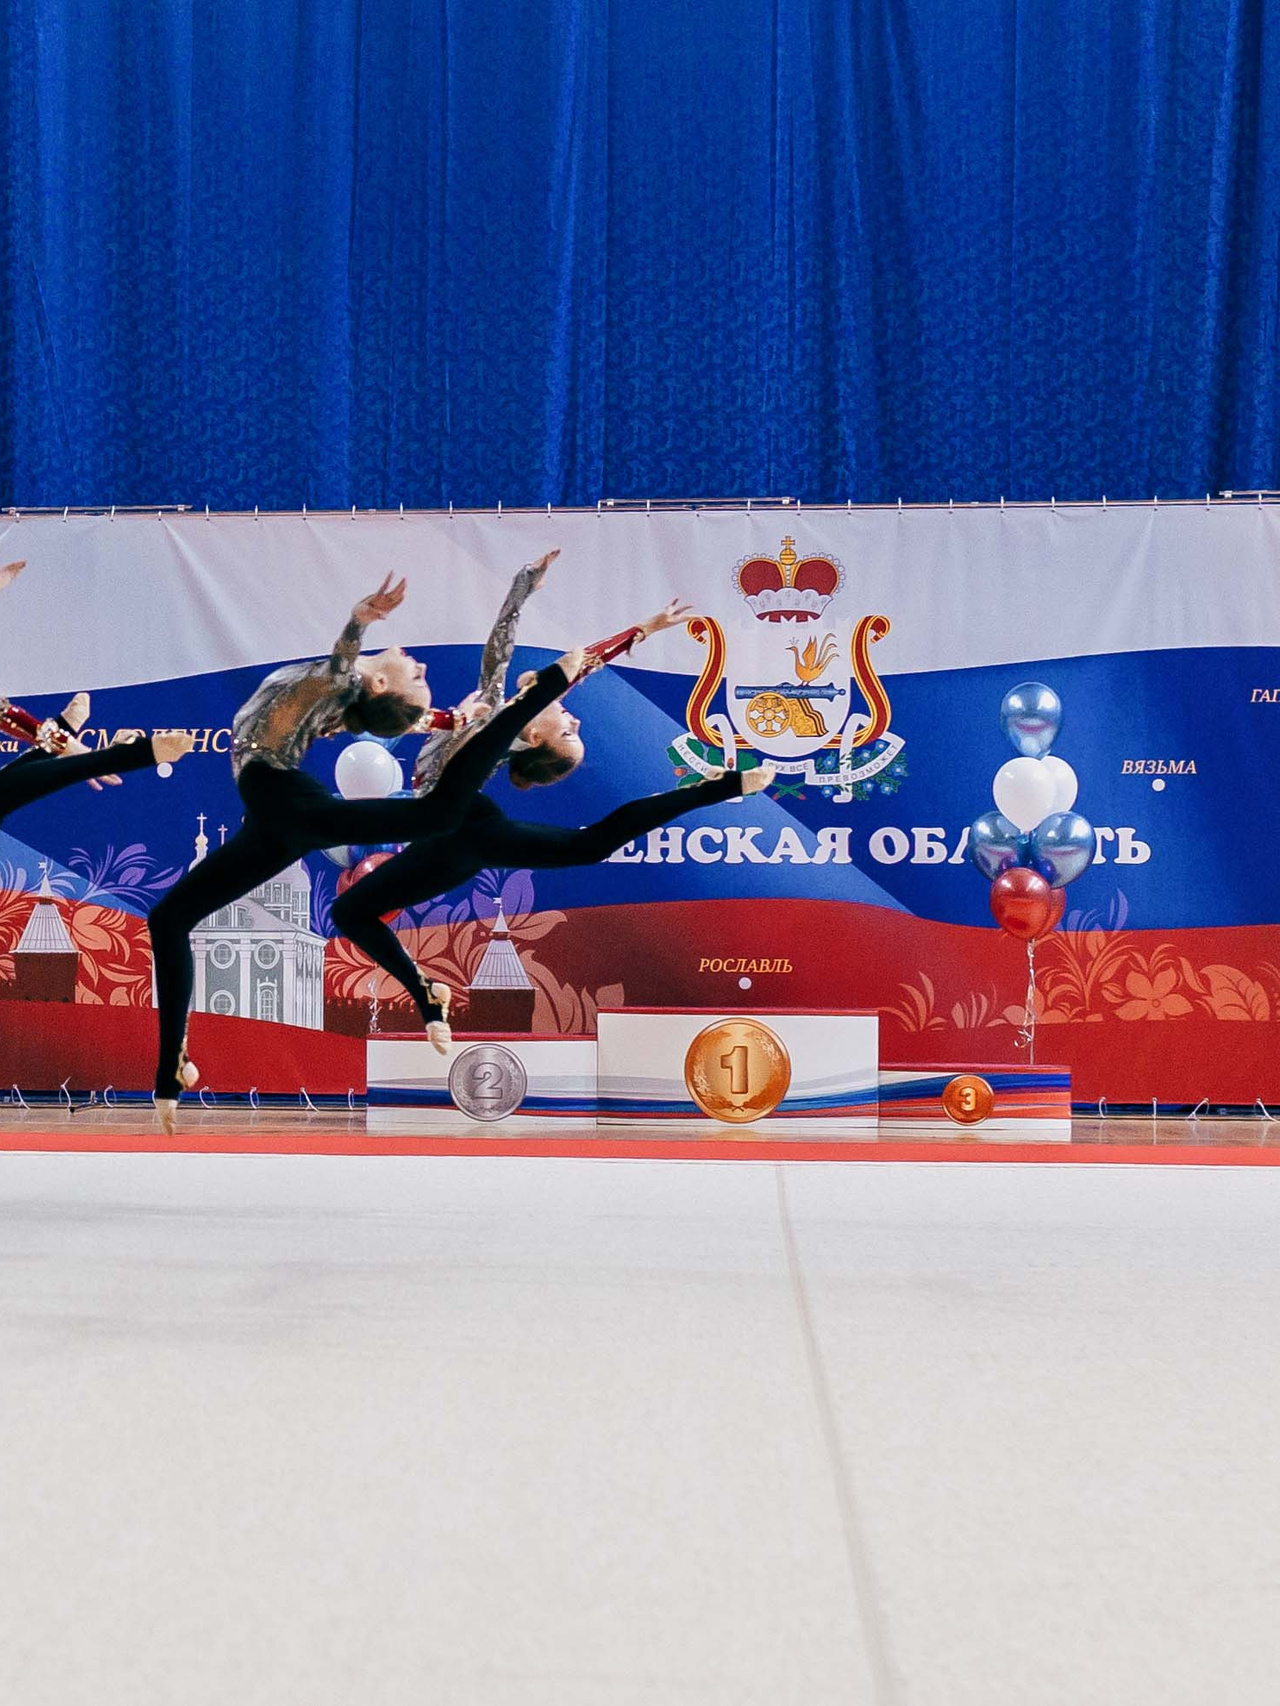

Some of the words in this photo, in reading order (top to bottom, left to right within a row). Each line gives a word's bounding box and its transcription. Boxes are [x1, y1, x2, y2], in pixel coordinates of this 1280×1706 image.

[818, 744, 898, 783] ПРЕВОЗМОЖЕТ
[1121, 759, 1197, 775] ВЯЗЬМА
[698, 958, 793, 973] РОСЛАВЛЬ
[471, 1062, 503, 1100] 2
[721, 1045, 748, 1094] 1
[960, 1086, 976, 1111] 3
